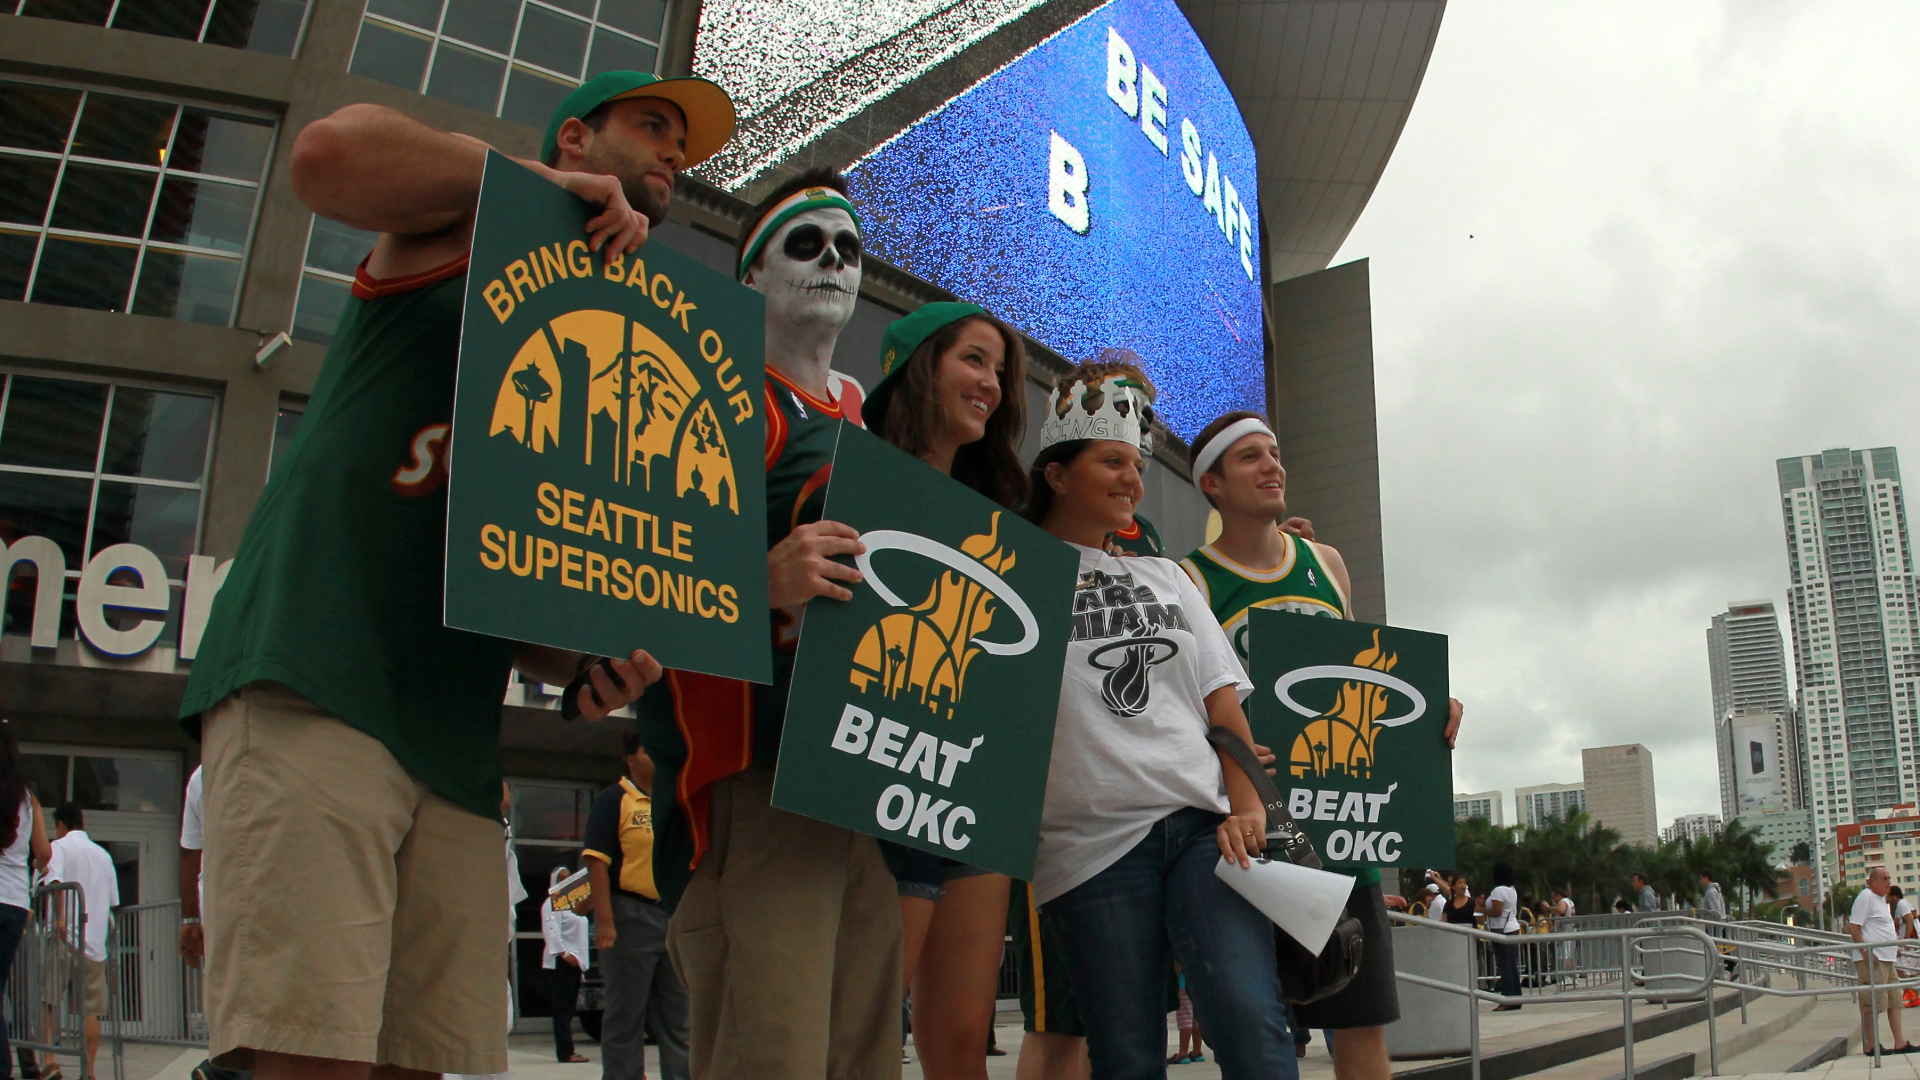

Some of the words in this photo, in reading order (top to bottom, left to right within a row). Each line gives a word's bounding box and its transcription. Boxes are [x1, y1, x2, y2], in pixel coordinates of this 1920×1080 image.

[1048, 128, 1090, 234] B
[1106, 26, 1169, 158] BE
[1180, 117, 1254, 282] SAFE
[482, 239, 593, 325] BRING
[603, 252, 698, 334] BACK
[699, 328, 754, 426] OUR
[1041, 417, 1109, 450] KING
[536, 481, 694, 563] SEATTLE
[479, 523, 740, 624] SUPERSONICS
[1073, 584, 1158, 613] ARE
[1079, 569, 1135, 589] WE
[1068, 603, 1194, 641] IAM
[830, 702, 985, 788] BEAT
[875, 783, 977, 851] OKC
[1288, 781, 1398, 824] BEAT
[1326, 829, 1403, 863] OKC
